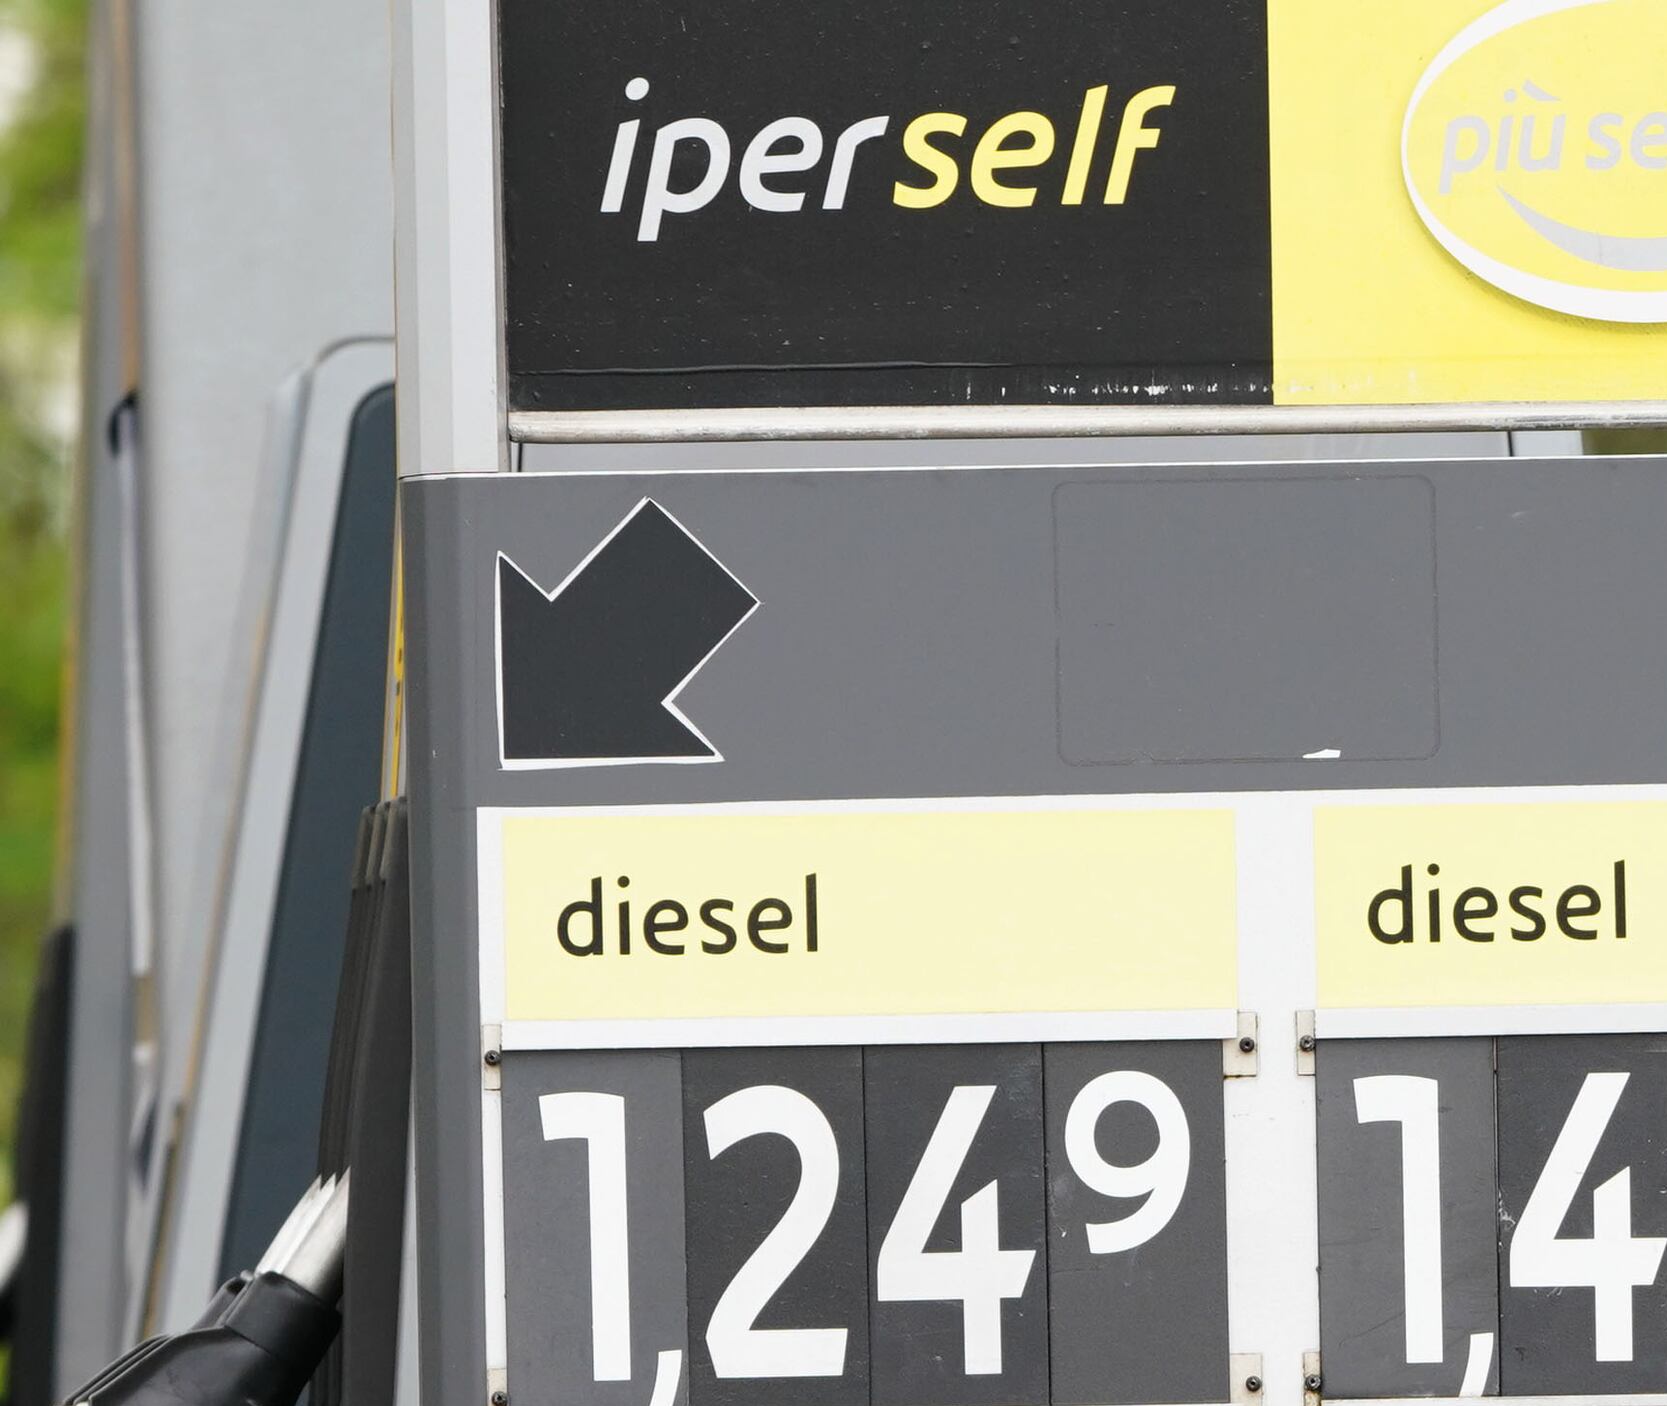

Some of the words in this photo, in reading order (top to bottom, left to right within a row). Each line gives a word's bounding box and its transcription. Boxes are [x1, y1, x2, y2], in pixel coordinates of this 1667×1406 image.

[600, 76, 1177, 242] iperself
[1437, 78, 1566, 196] più
[557, 873, 818, 957] diesel
[1367, 860, 1627, 945] diesel
